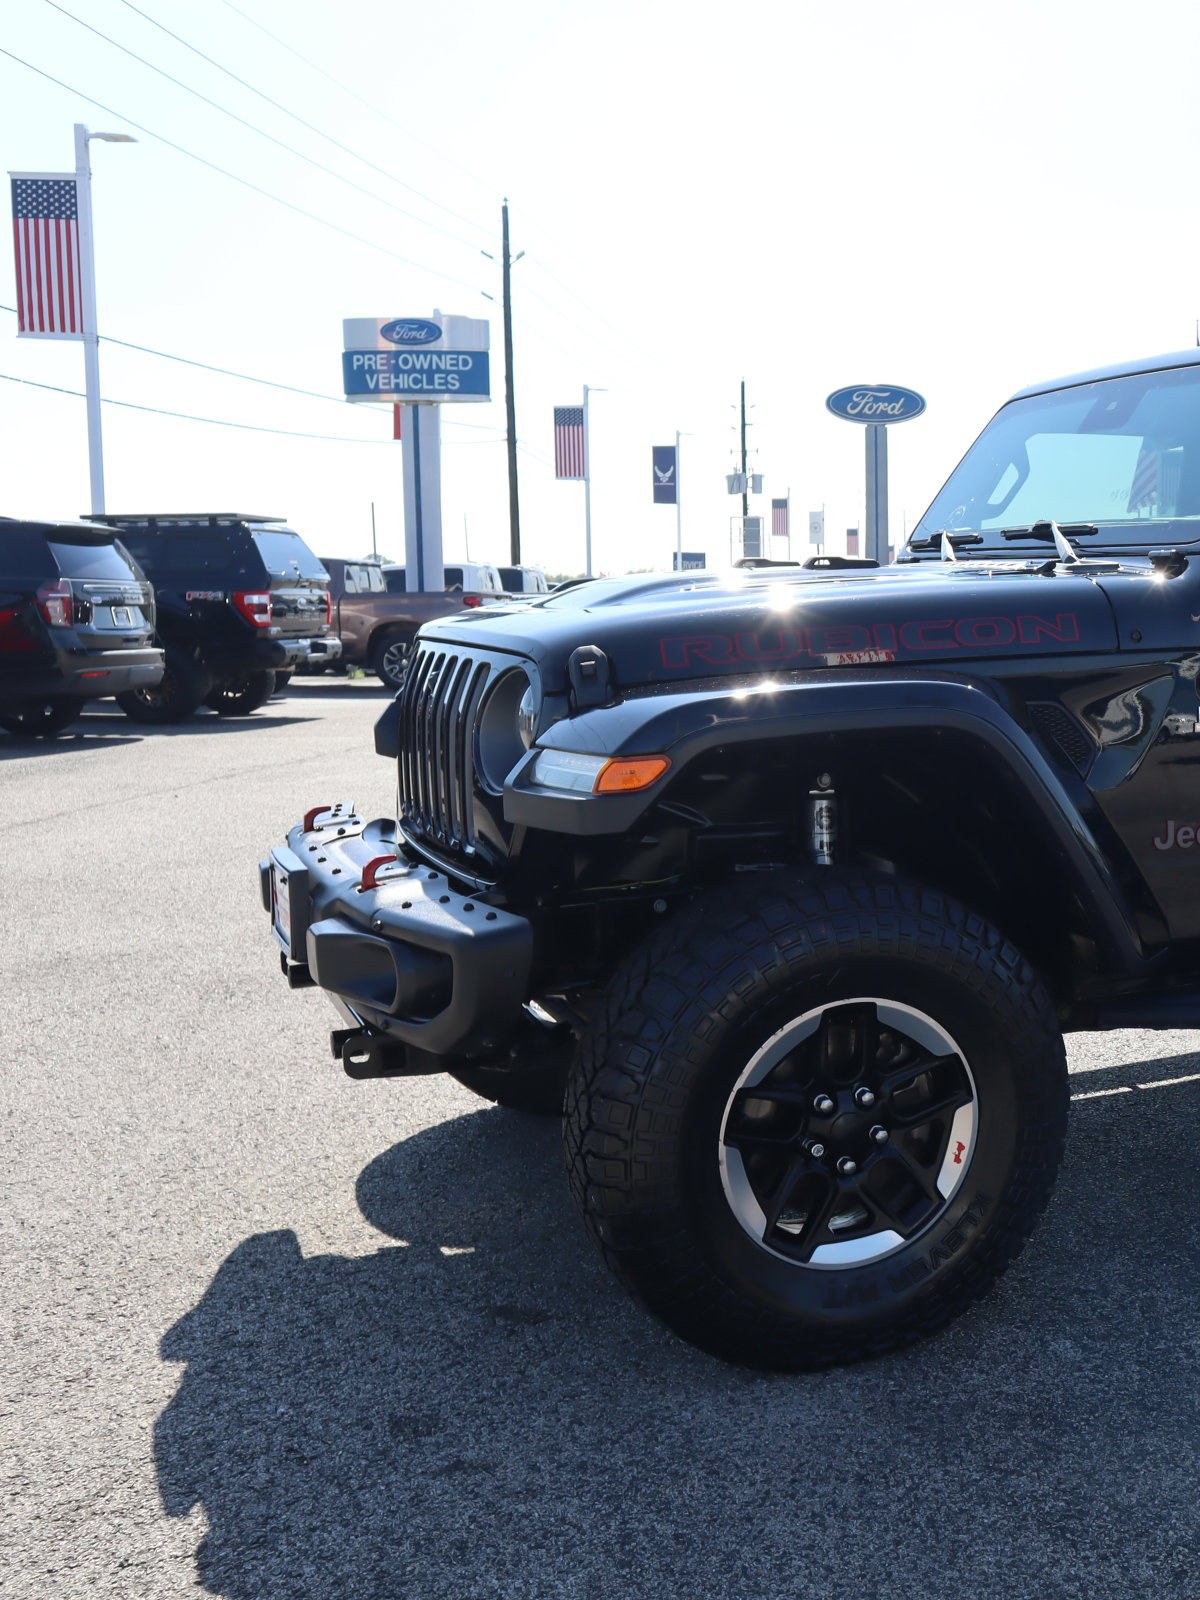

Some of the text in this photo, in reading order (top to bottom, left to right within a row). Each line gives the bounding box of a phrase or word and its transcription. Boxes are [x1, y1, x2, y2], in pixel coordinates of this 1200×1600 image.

[392, 322, 428, 339] Ford
[365, 373, 461, 390] VEHICLES
[846, 390, 906, 414] Ford
[674, 560, 704, 570] SRVICE
[660, 613, 1081, 668] RUBICON
